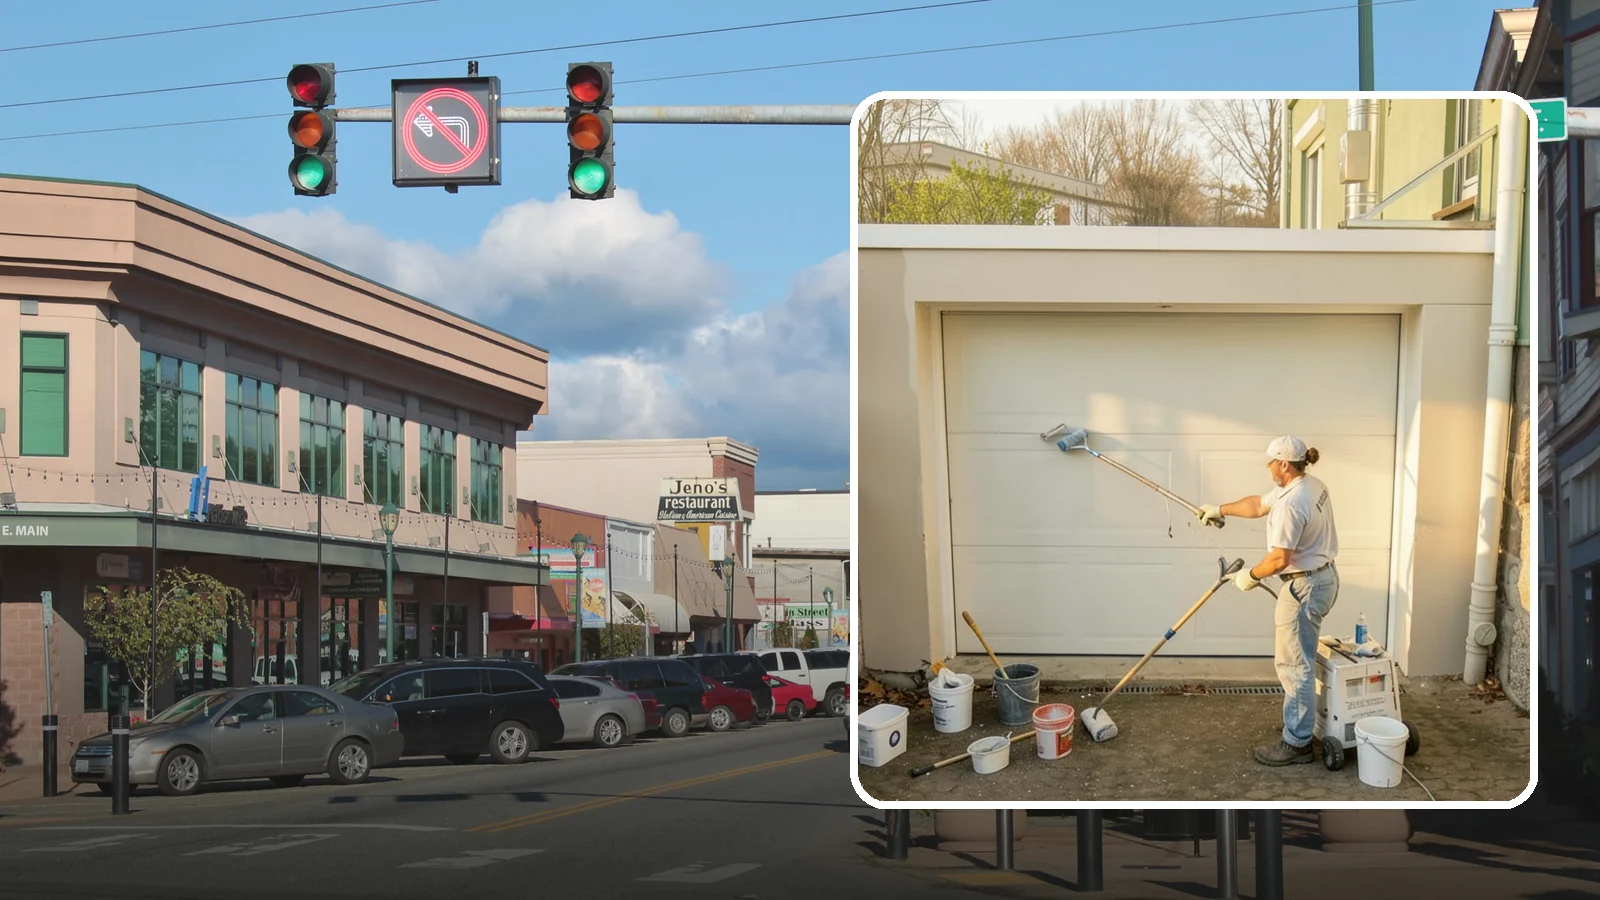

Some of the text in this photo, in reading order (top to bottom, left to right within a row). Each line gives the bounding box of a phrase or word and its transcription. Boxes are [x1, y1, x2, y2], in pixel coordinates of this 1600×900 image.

[669, 480, 728, 495] Jeno's
[665, 496, 731, 509] restaurant
[658, 510, 681, 520] Italian
[686, 509, 715, 520] American
[714, 509, 738, 520] Cuisine
[2, 525, 49, 536] E. MAIN
[797, 607, 829, 617] Street
[790, 619, 824, 627] lass
